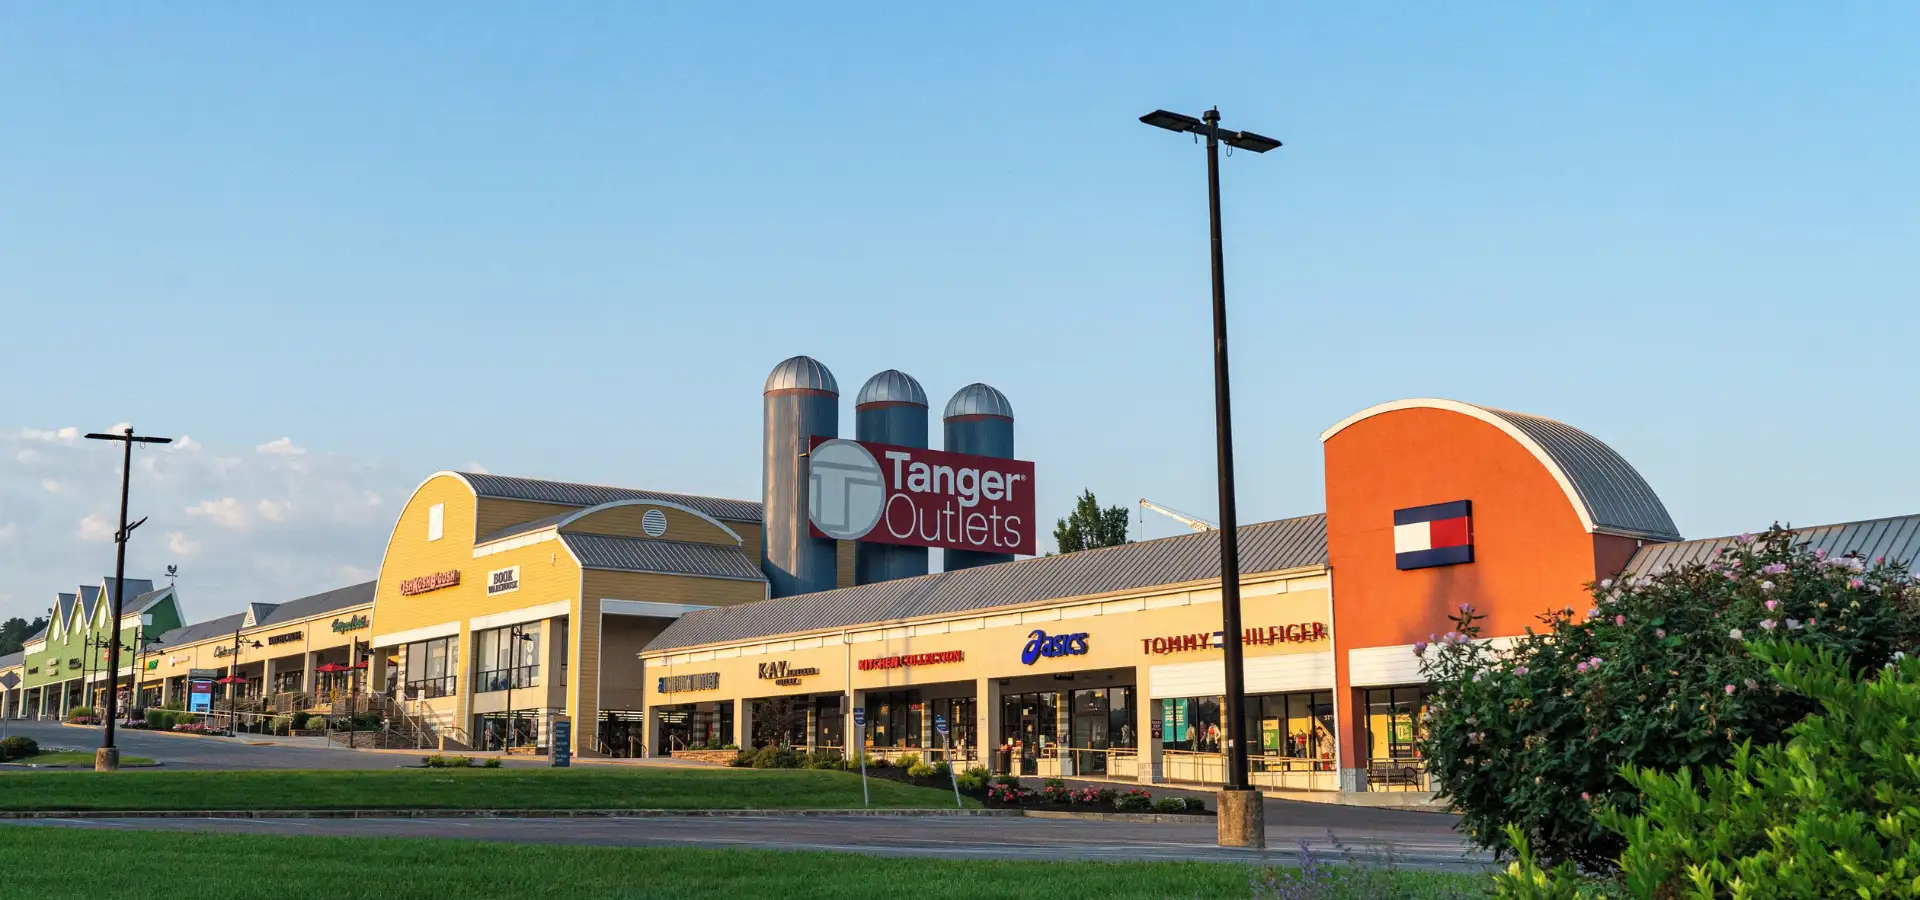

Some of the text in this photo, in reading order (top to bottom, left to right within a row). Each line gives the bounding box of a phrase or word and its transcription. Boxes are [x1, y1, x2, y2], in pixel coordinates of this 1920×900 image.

[885, 493, 1021, 548] Outlets
[493, 569, 514, 585] BOOK
[488, 580, 518, 594] WAREHOUSE
[1140, 632, 1210, 655] TOMMY
[758, 660, 788, 679] KAY
[858, 650, 963, 670] KITCHEN COLLECTION
